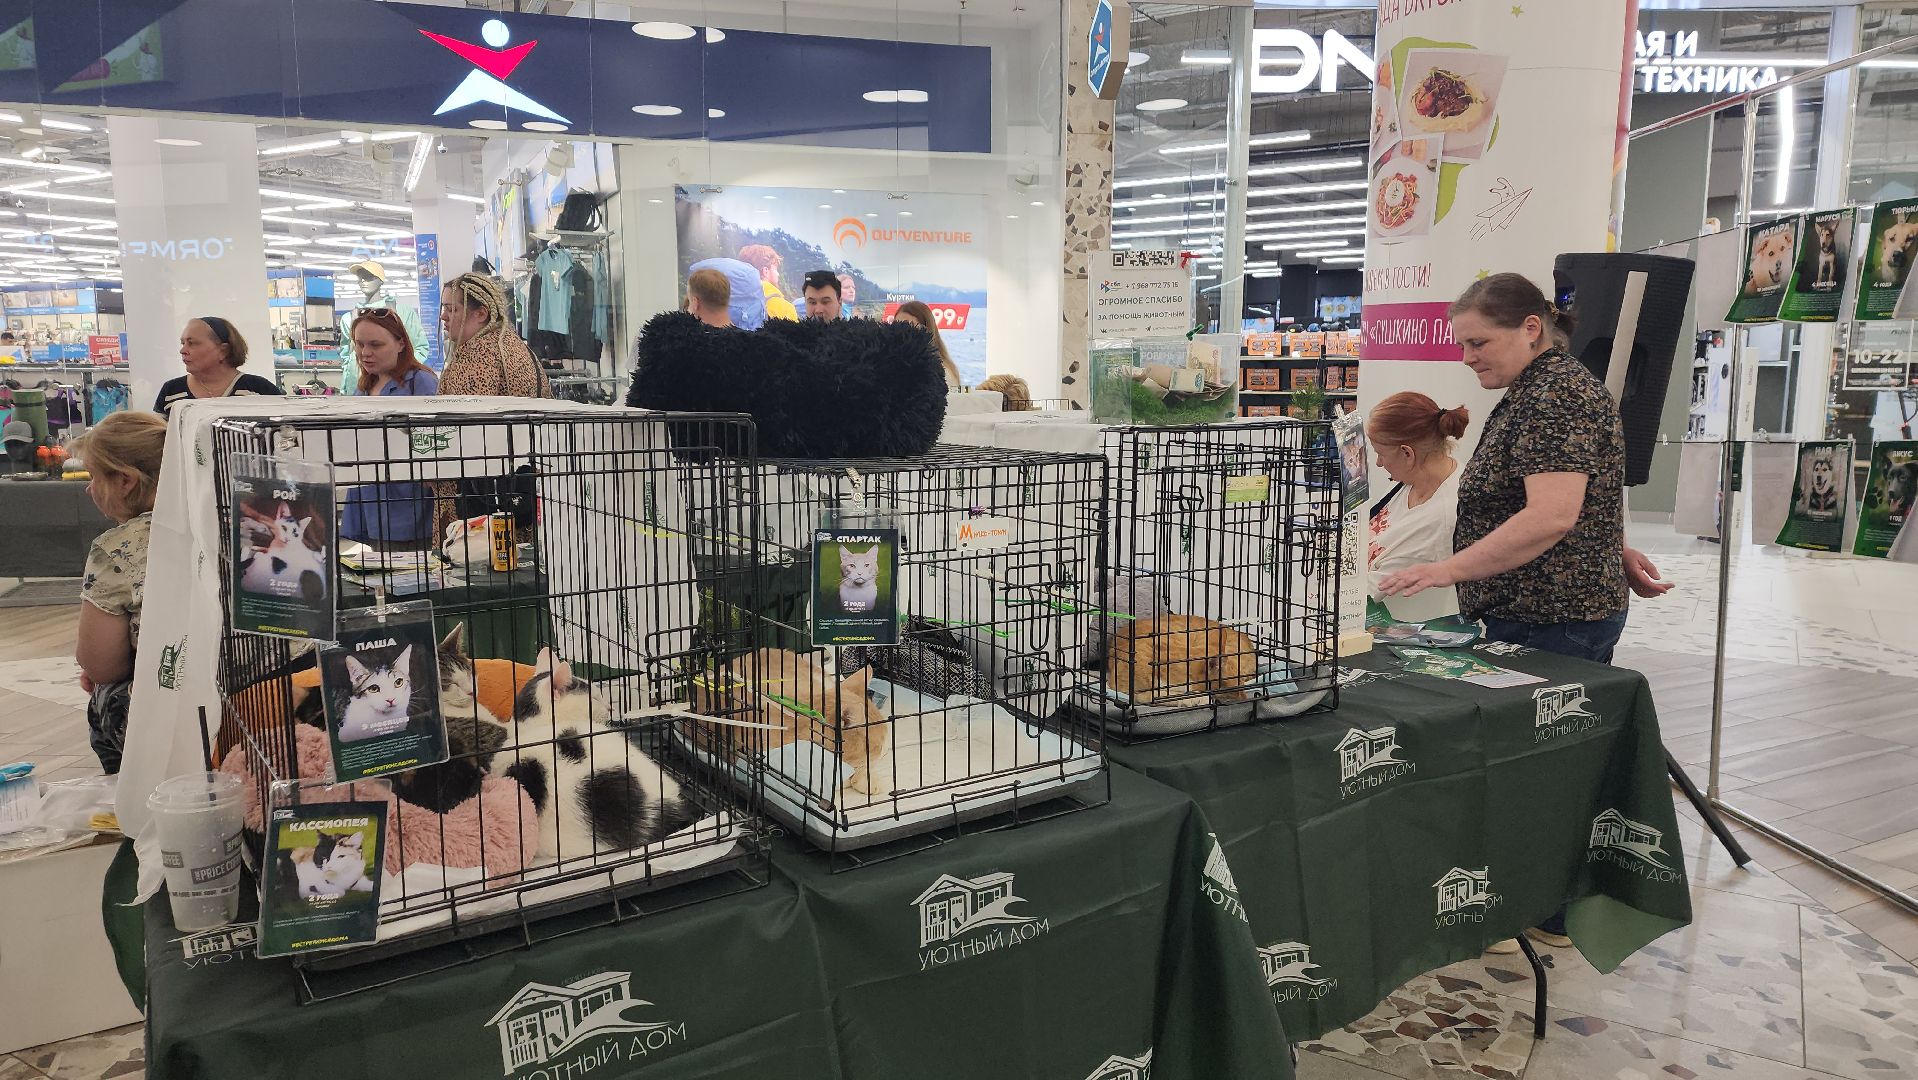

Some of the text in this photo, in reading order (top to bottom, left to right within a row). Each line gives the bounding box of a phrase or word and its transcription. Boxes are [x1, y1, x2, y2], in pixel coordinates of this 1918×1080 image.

[1675, 30, 1698, 57] И
[1641, 66, 1777, 93] ТЕХНИКА
[871, 228, 973, 243] OUTVENTURE
[1392, 262, 1431, 289] ГОСТИ!
[886, 293, 915, 301] Куртки
[1098, 295, 1183, 305] ОГРОМНОЕ СПАСИБО
[1109, 312, 1142, 320] ПОМОЩЬ
[1143, 311, 1185, 319] ЖИВОТНЫМ
[1369, 318, 1428, 345] «ПУШКИНО
[1433, 318, 1457, 345] ПА
[1853, 350, 1903, 364] 10-22
[836, 535, 881, 543] СПАРТАК
[355, 637, 398, 652] ПАША
[1534, 714, 1602, 744] УЮТНЫЙ ДОМ
[1388, 762, 1416, 782] ДОМ
[289, 817, 369, 832] КАССИОПЕЯ
[199, 863, 225, 881] PRICE
[1586, 850, 1682, 885] УЮТНЫЙ ДОМ
[918, 917, 1050, 971] УЮТНЫЙ ДОМ
[1307, 978, 1338, 1001] ДОМ
[628, 1021, 687, 1061] ДОМ
